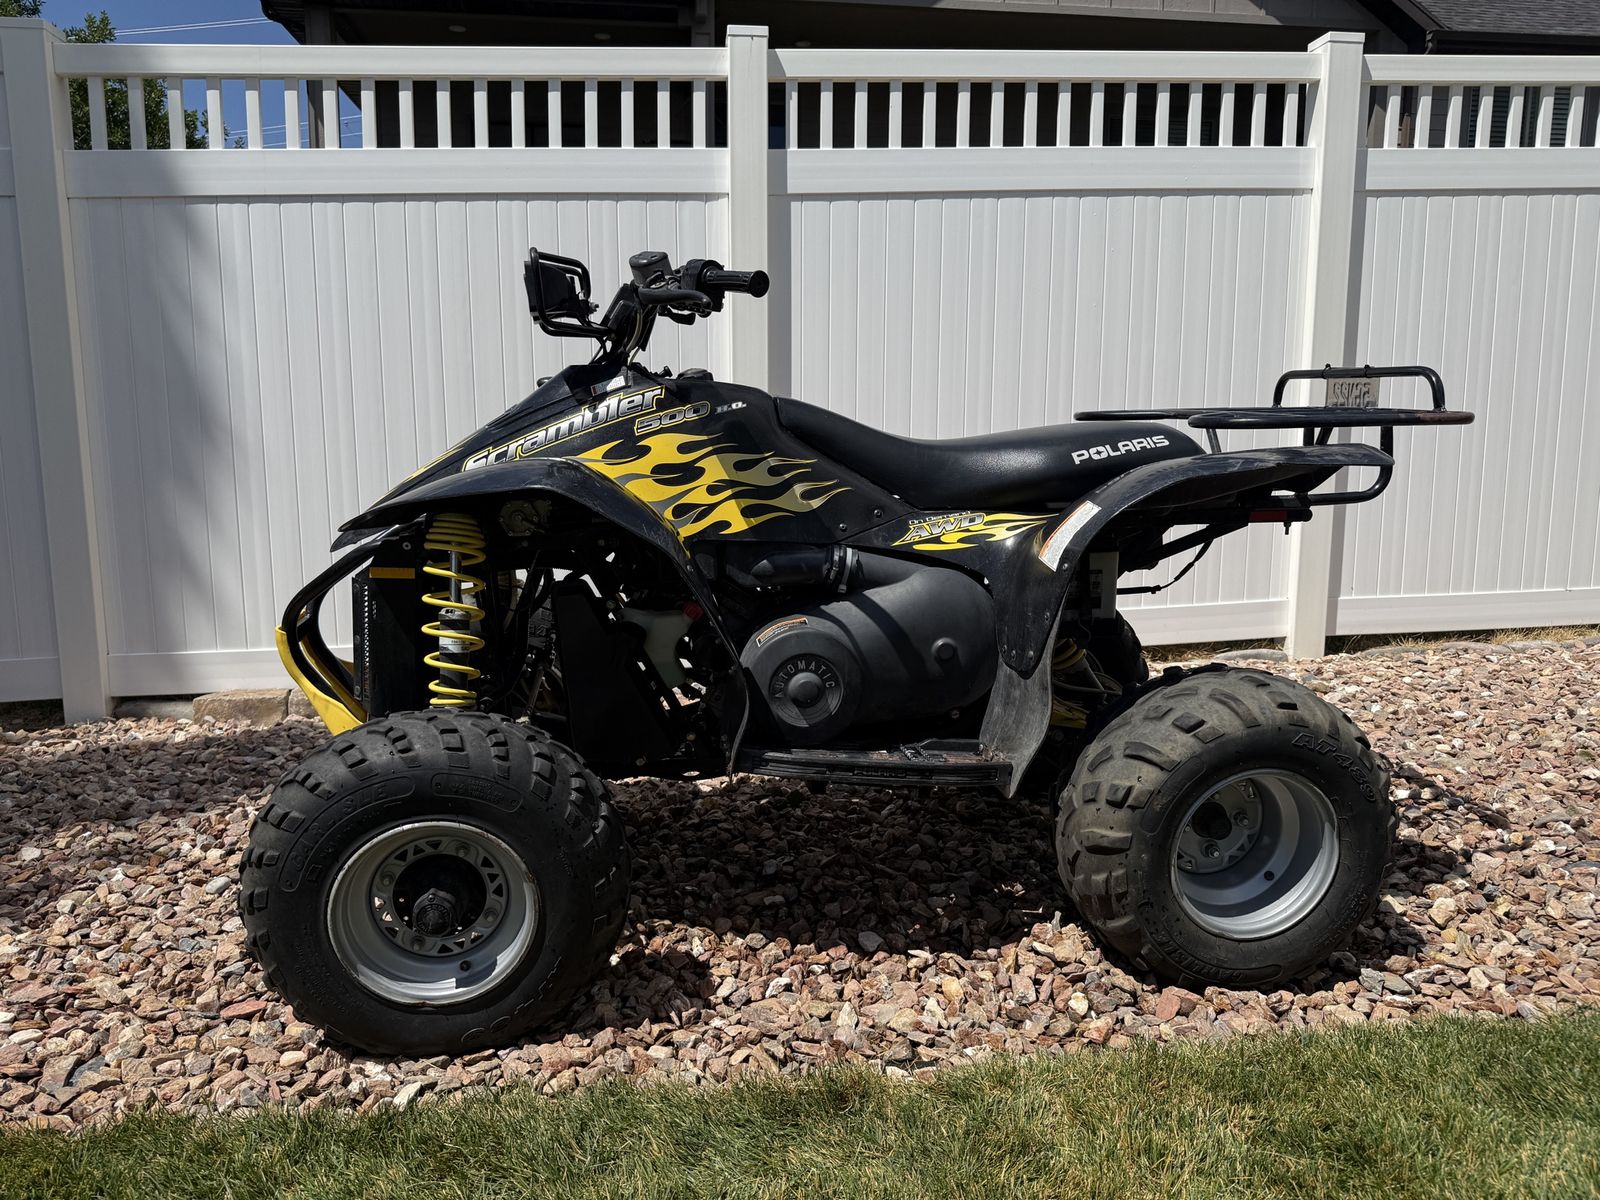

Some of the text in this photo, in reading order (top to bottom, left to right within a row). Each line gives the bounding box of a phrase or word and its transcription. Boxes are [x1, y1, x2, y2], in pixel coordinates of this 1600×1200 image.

[635, 401, 711, 435] 500
[1071, 435, 1170, 465] POLARIS
[903, 513, 985, 542] AWD
[775, 660, 836, 698] AUTOMATIC
[1292, 732, 1376, 802] AT489
